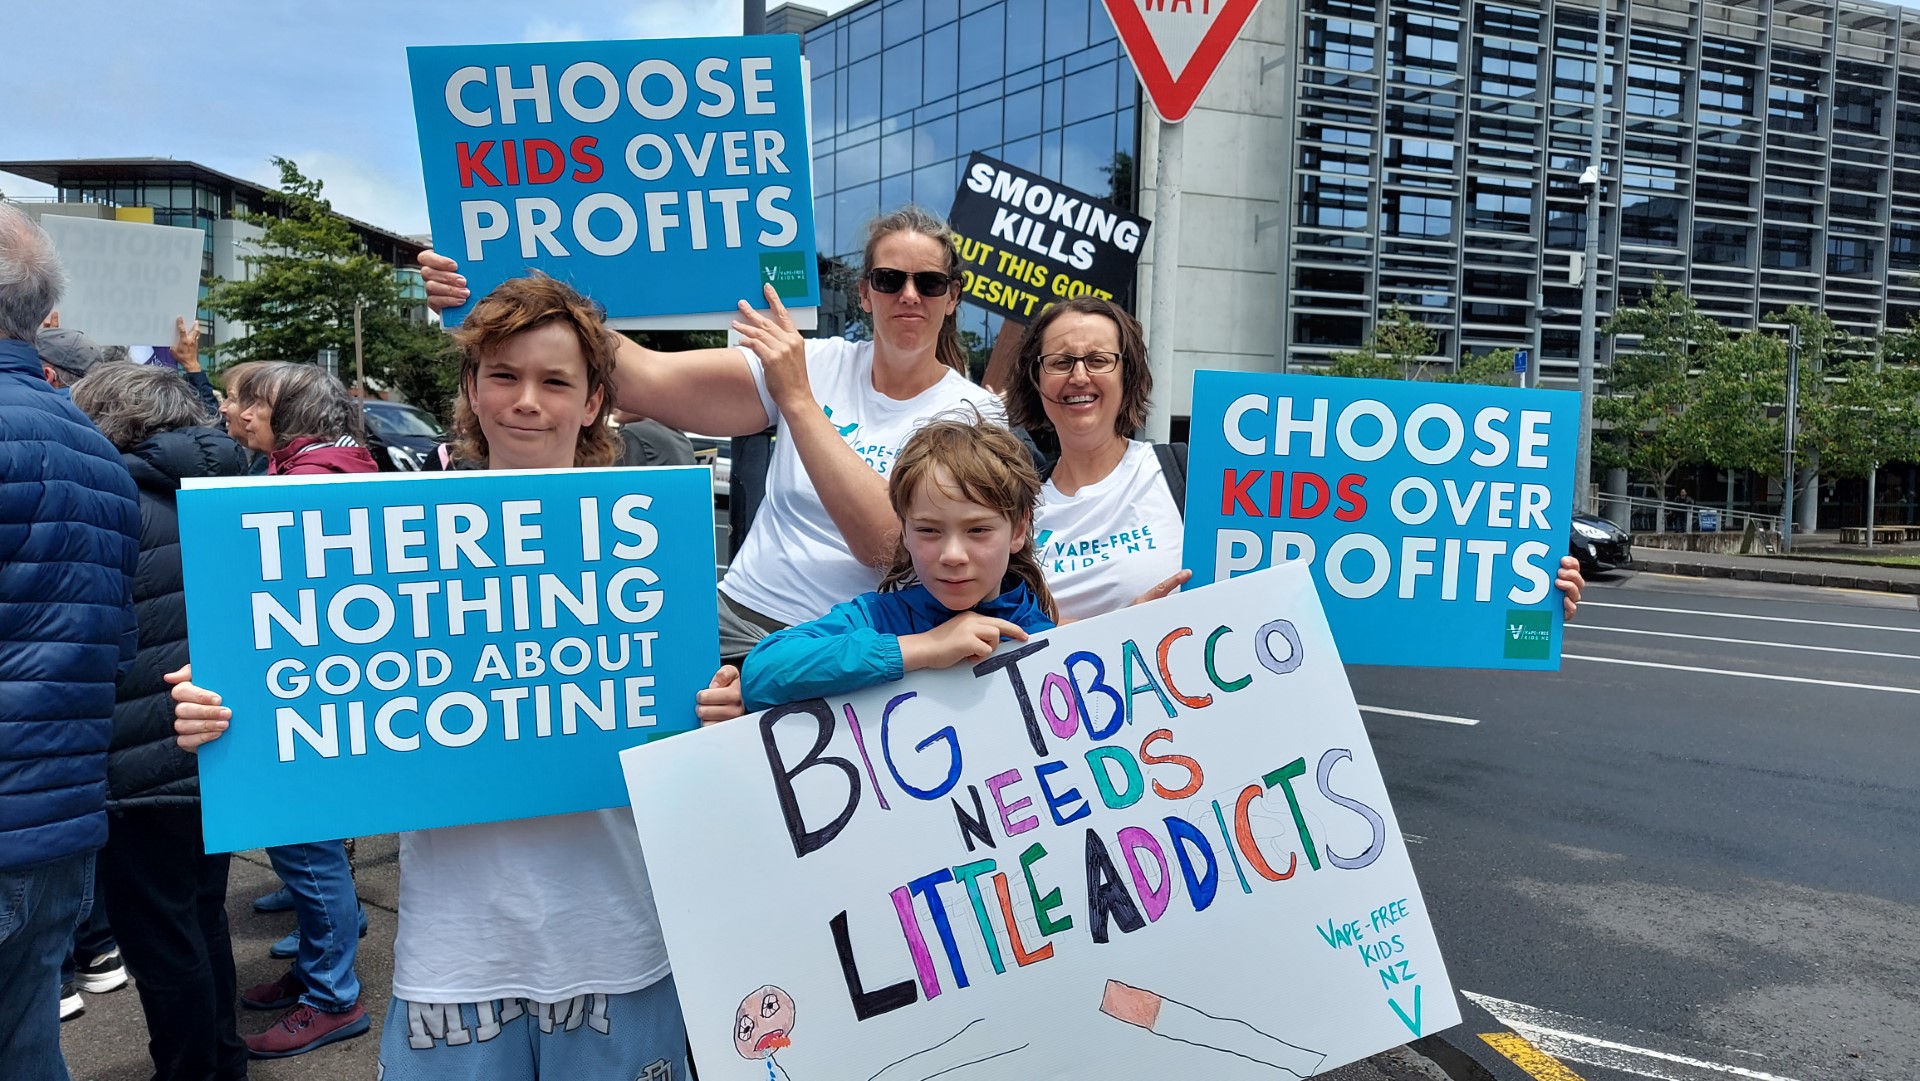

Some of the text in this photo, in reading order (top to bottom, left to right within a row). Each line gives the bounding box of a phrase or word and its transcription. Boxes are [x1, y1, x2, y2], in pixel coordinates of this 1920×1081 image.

[445, 57, 776, 127] CHOOSE
[455, 130, 792, 188] KIDS OVER
[460, 186, 798, 261] PROFITS
[966, 163, 1141, 253] SMOKING
[990, 207, 1096, 270] KILLS
[961, 270, 1039, 317] OESN'T
[996, 250, 1049, 288] THIS
[1222, 393, 1553, 469] CHOOSE
[1221, 468, 1553, 530] KIDS OVER
[241, 493, 660, 581] THERE IS
[1054, 525, 1152, 557] VAPE-FREE
[1054, 537, 1157, 574] KIDS NZ
[1214, 528, 1551, 606] PROFITS
[250, 566, 665, 650] NOTHING
[265, 631, 660, 699] GOOD ABOUT
[275, 675, 658, 762] NICOTINE
[759, 618, 1304, 859] BIG TOBACCO
[951, 727, 1205, 852] NEEDS
[829, 748, 1386, 1022] LITTLE ADDICTS
[1358, 935, 1405, 967] KIDS
[1379, 960, 1418, 990] NZ
